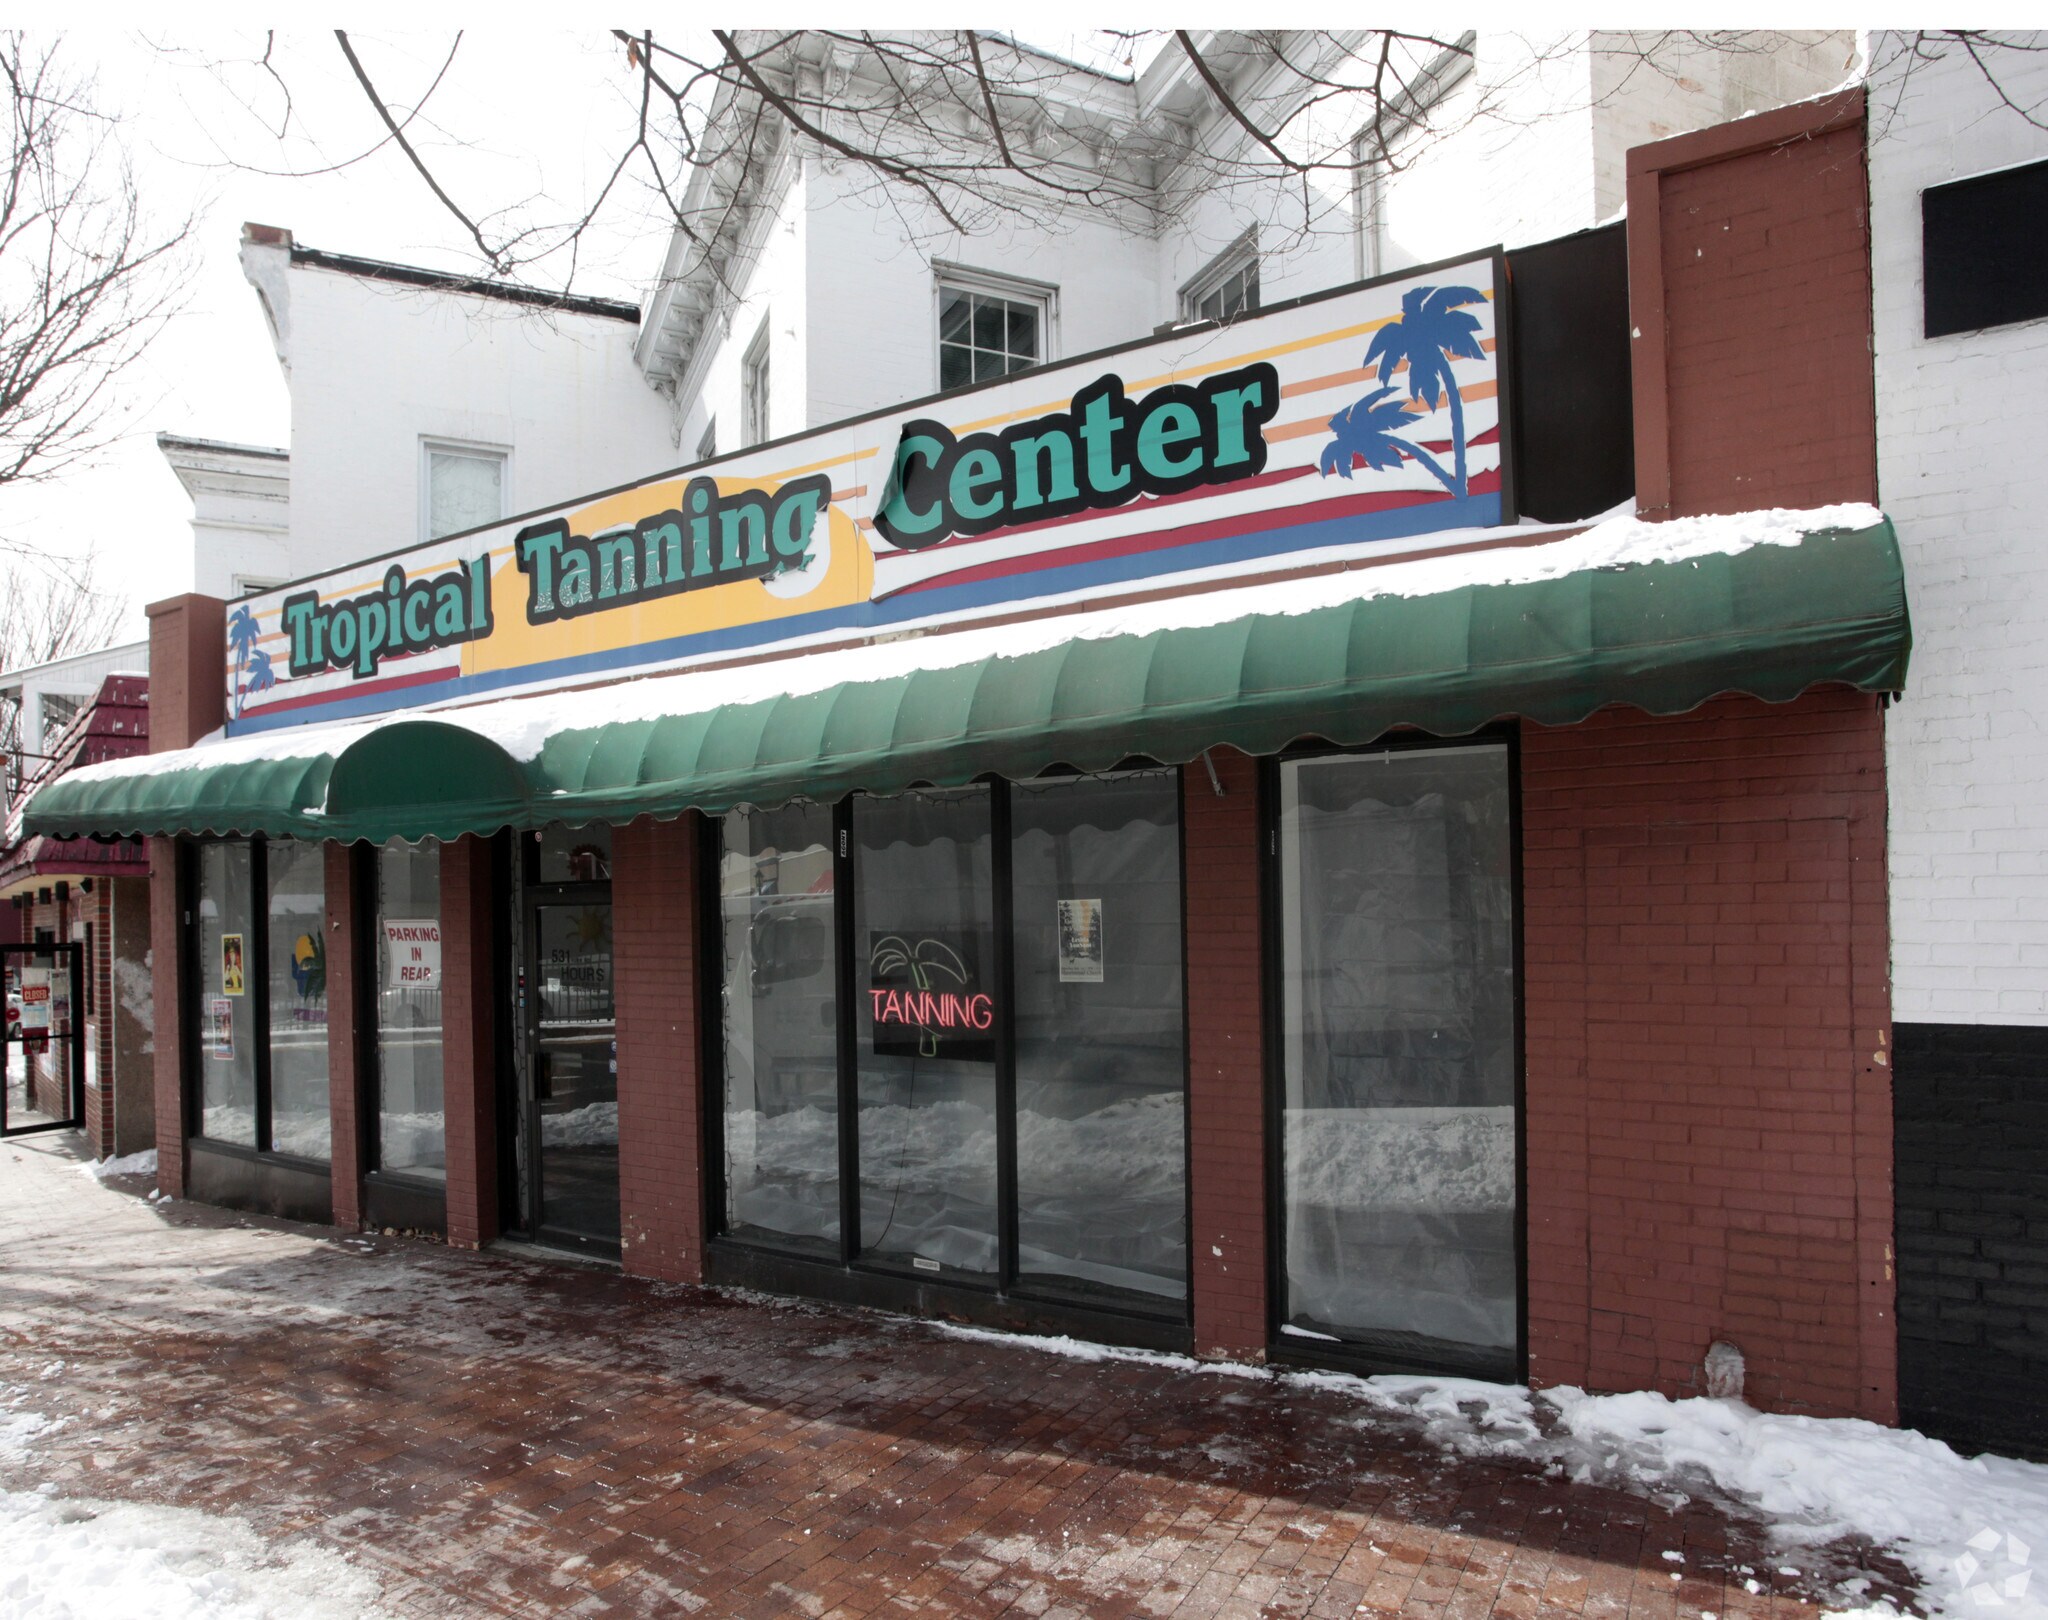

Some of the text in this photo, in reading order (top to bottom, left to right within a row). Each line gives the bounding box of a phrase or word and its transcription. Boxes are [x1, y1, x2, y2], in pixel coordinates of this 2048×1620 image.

[285, 552, 490, 677] Tropical
[884, 379, 1264, 536] Center
[388, 927, 439, 942] PARKING
[411, 947, 422, 961] IN
[551, 949, 570, 963] 531
[401, 966, 431, 981] REAR
[561, 966, 604, 982] HOURS
[24, 989, 47, 1001] CLOSED
[868, 989, 992, 1030] TANNING
